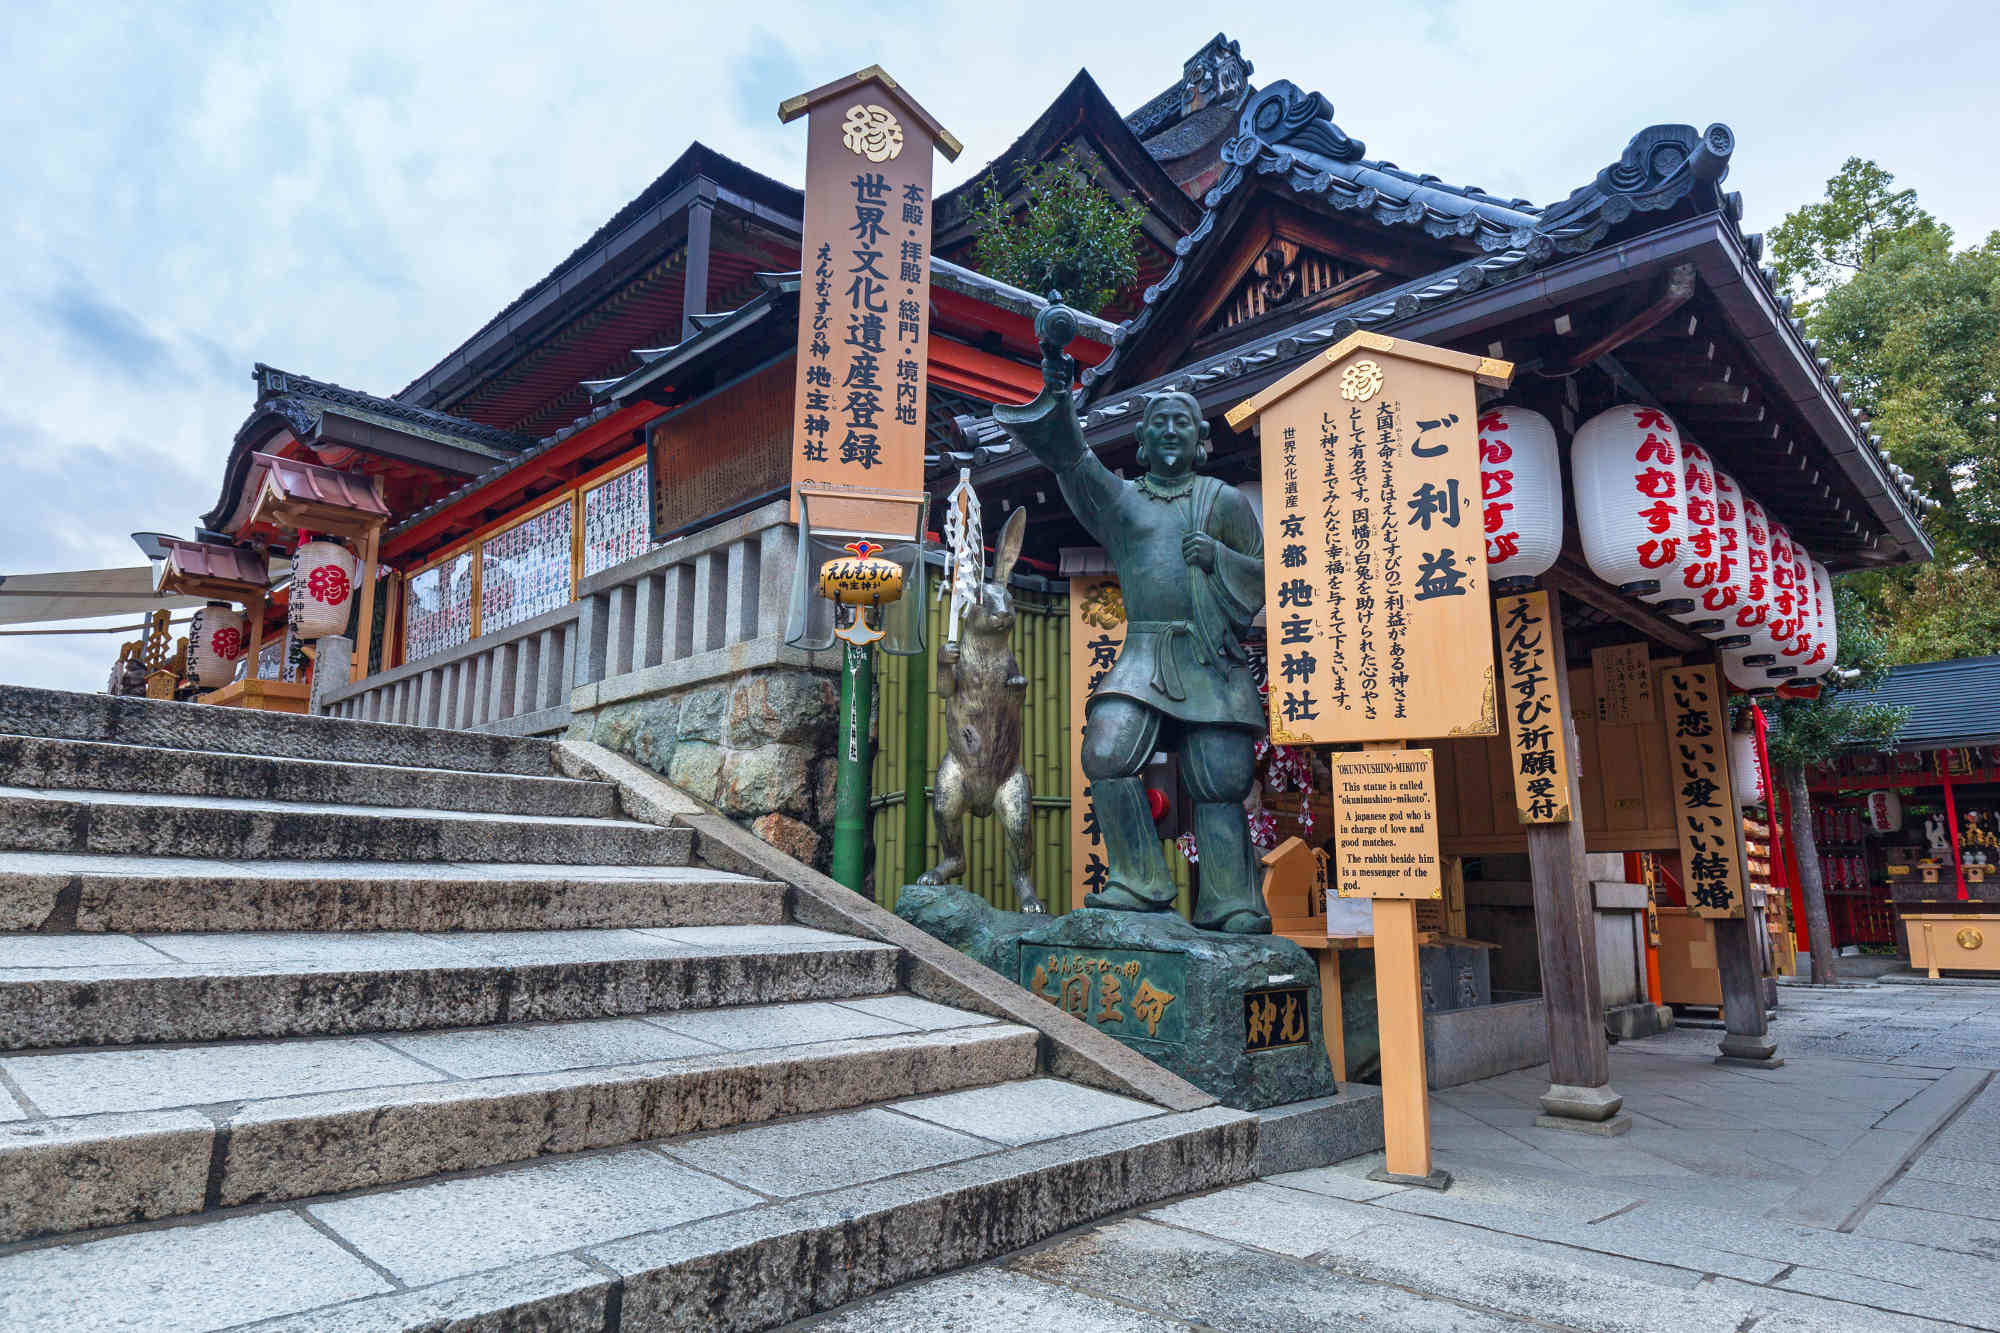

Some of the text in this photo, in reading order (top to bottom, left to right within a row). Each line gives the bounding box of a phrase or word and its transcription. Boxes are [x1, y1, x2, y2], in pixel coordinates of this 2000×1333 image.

[839, 173, 892, 470] 世界文化遺産登録
[802, 365, 831, 462] 地主神社
[1633, 408, 1680, 569] えんむすび
[1408, 414, 1467, 601] ご利益
[828, 562, 895, 581] えんむすび
[1278, 427, 1320, 722] 世界文化遺産 京都 地主神社
[1505, 598, 1558, 819] えんむすび祈願受付
[1343, 781, 1423, 792] This statue is called
[1345, 811, 1431, 822] A japanese god who is
[1340, 824, 1424, 835] in charge of love and
[1341, 838, 1396, 847] good matches.
[1346, 853, 1434, 863] The rabbit beside him
[1342, 867, 1349, 876] is
[1360, 868, 1400, 878] messenger
[1404, 867, 1411, 876] of
[1415, 867, 1428, 876] the
[1343, 880, 1360, 890] god.
